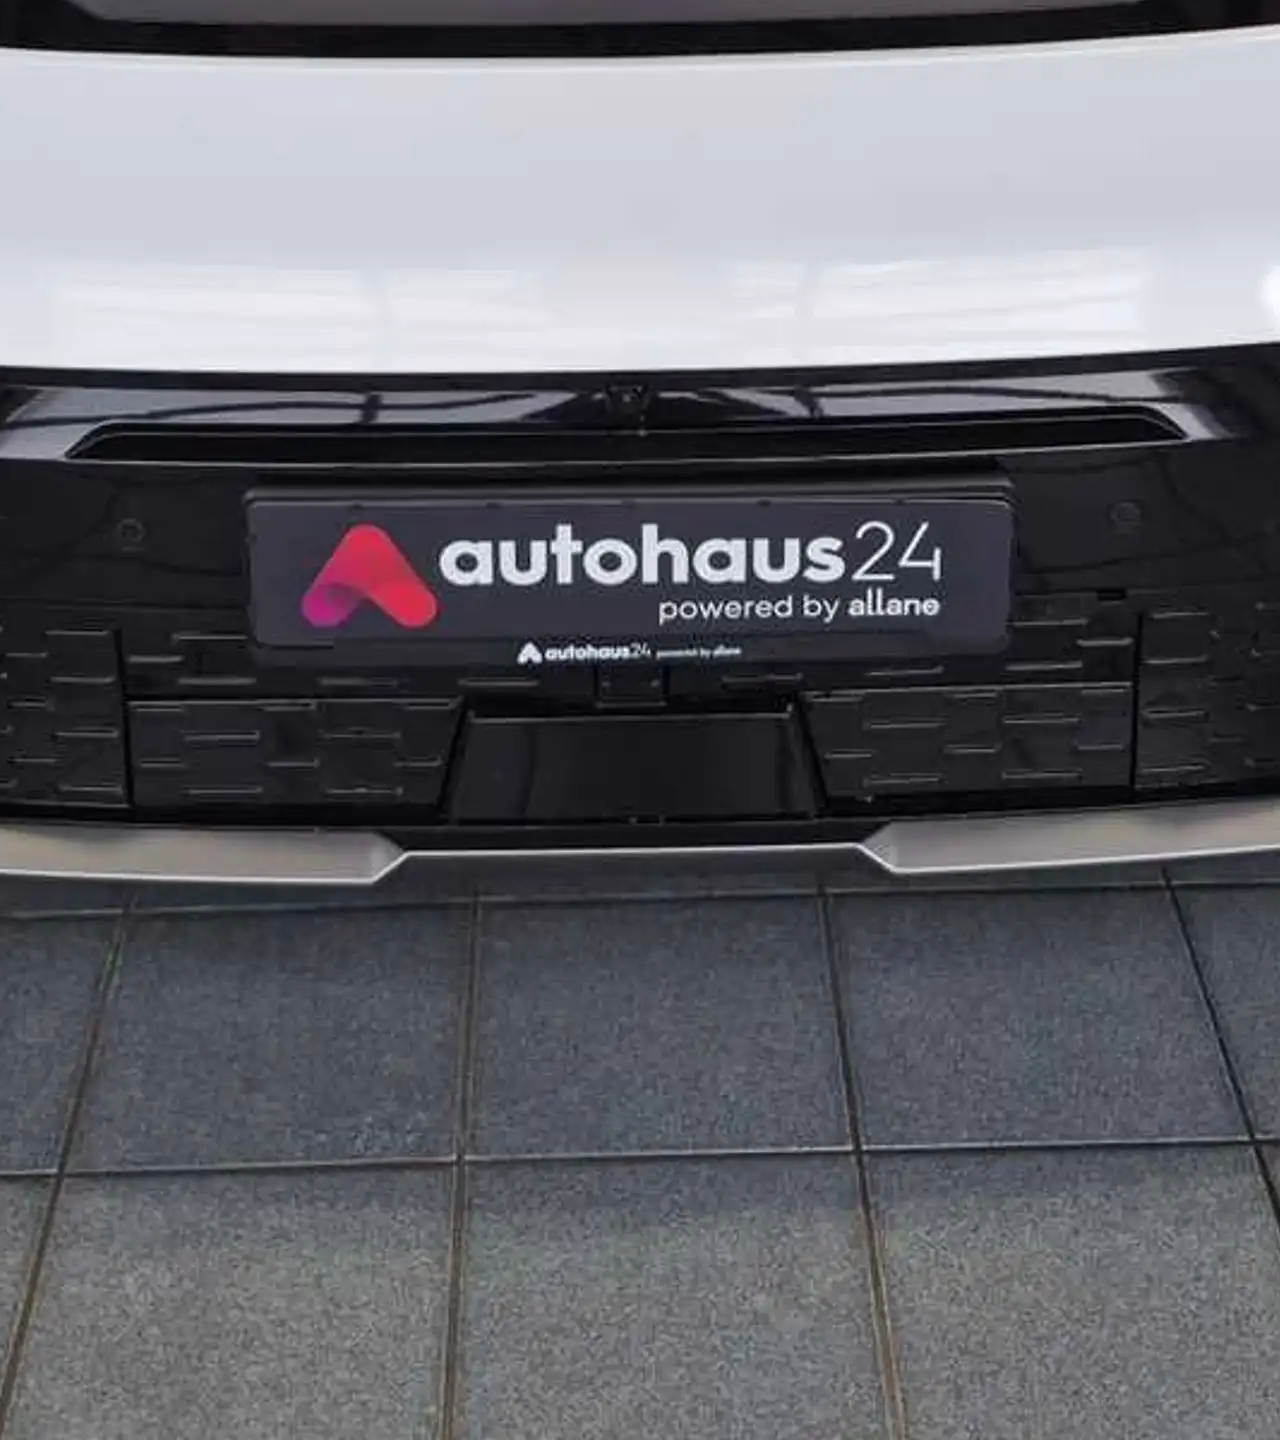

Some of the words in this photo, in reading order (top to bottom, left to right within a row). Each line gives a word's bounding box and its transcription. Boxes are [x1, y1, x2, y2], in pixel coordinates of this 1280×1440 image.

[439, 521, 942, 585] autohaus24
[658, 595, 794, 626] powered
[802, 593, 840, 622] by
[847, 588, 941, 617] allane
[544, 643, 652, 661] autohaus24
